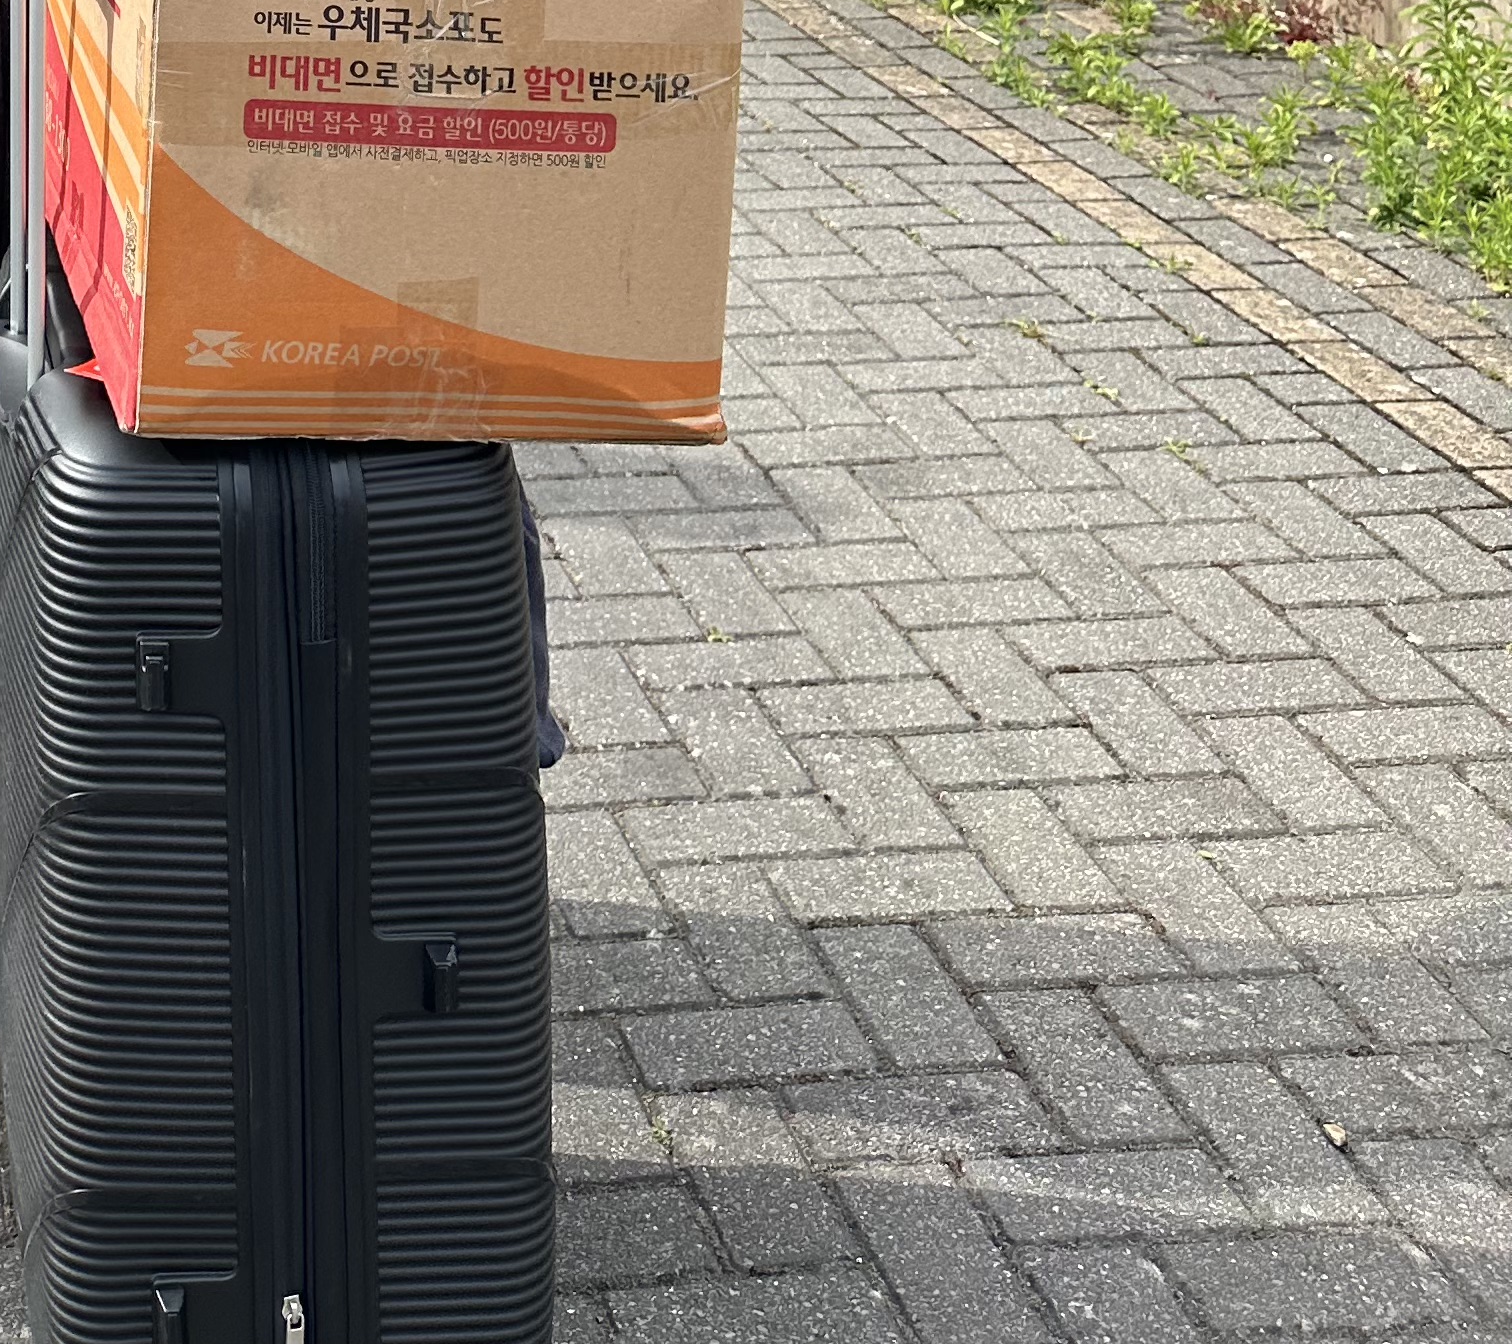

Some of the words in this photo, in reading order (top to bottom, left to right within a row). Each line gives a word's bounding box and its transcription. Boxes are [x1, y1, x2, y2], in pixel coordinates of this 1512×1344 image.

[253, 10, 313, 35] 이제는
[408, 62, 517, 95] 접수하고
[253, 108, 316, 134] 비대면
[322, 109, 363, 136] 접수
[369, 112, 388, 138] 및
[396, 114, 436, 140] 요금
[443, 115, 483, 141] 할인
[488, 119, 607, 147] (500원/통당)
[327, 144, 363, 159] 앱에서
[445, 148, 493, 165] 픽업장소
[497, 151, 544, 168] 지정하면
[546, 153, 581, 169] 500원
[584, 154, 607, 170] 할인
[261, 339, 361, 367] KOREA
[367, 345, 442, 369] POST
